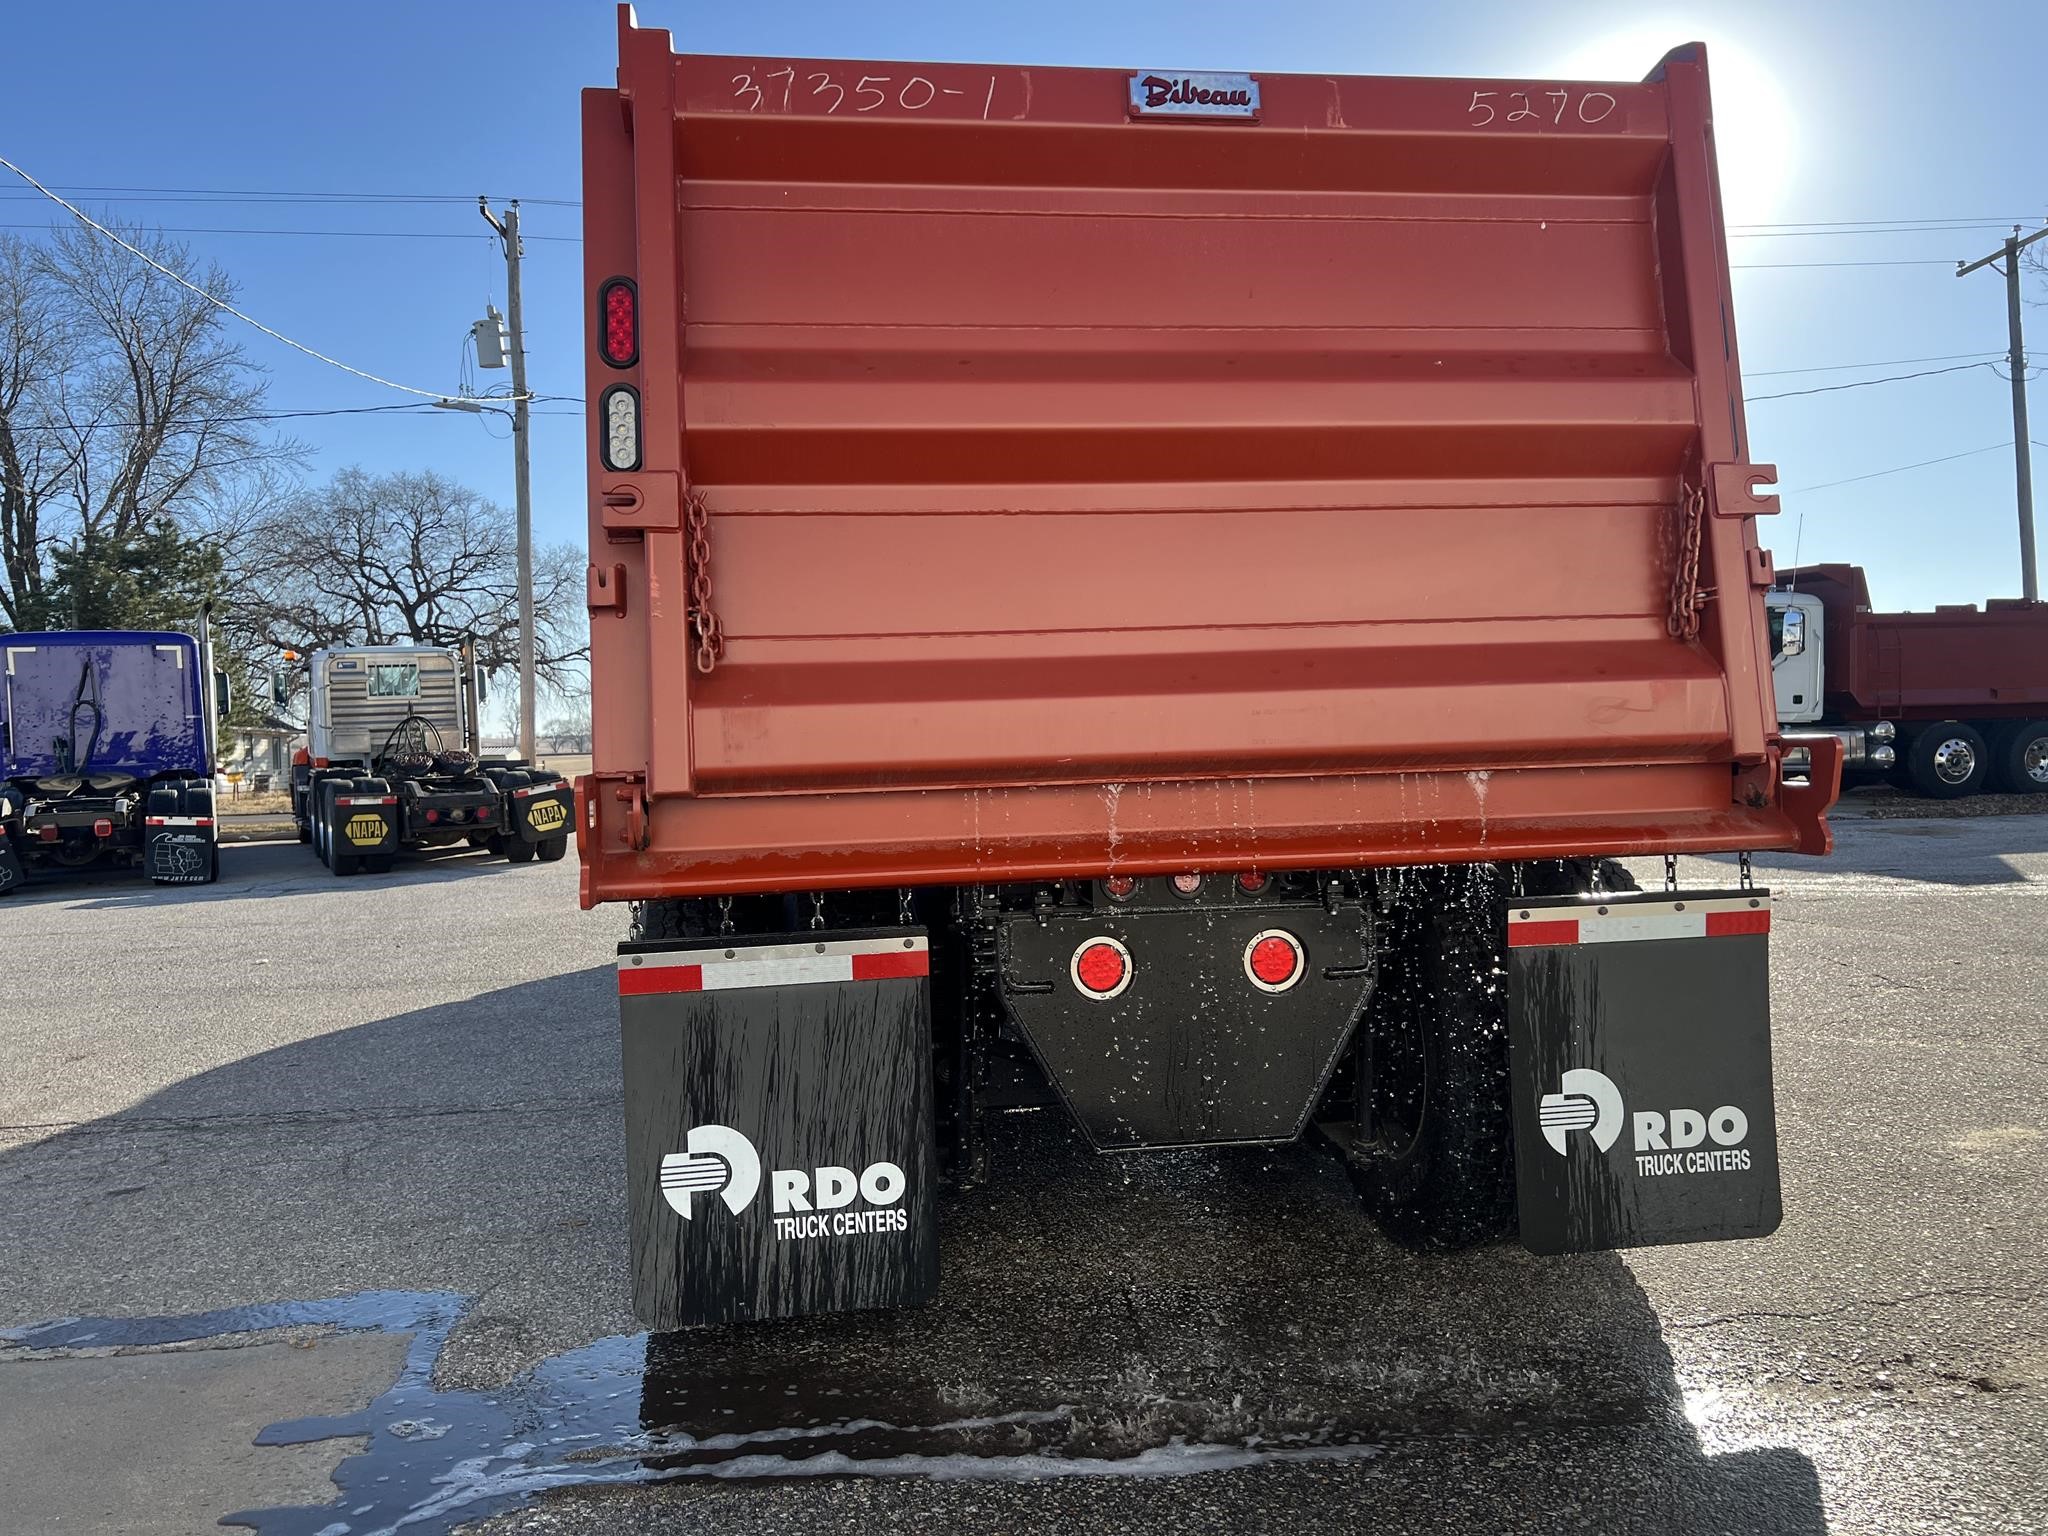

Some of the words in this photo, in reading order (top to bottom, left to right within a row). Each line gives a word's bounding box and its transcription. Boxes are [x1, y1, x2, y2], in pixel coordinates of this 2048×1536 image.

[731, 67, 995, 120] 37350-1
[1141, 75, 1251, 108] Bibeau
[1468, 89, 1616, 127] 5270
[533, 802, 562, 824] NAPA
[352, 821, 382, 839] NAPA
[1633, 1105, 1749, 1152] RDO
[1635, 1153, 1685, 1177] TRUCK
[1686, 1149, 1751, 1174] CENTERS
[771, 1161, 906, 1214] RDO
[773, 1214, 830, 1241] TRUCK
[833, 1208, 908, 1236] CENTERS
